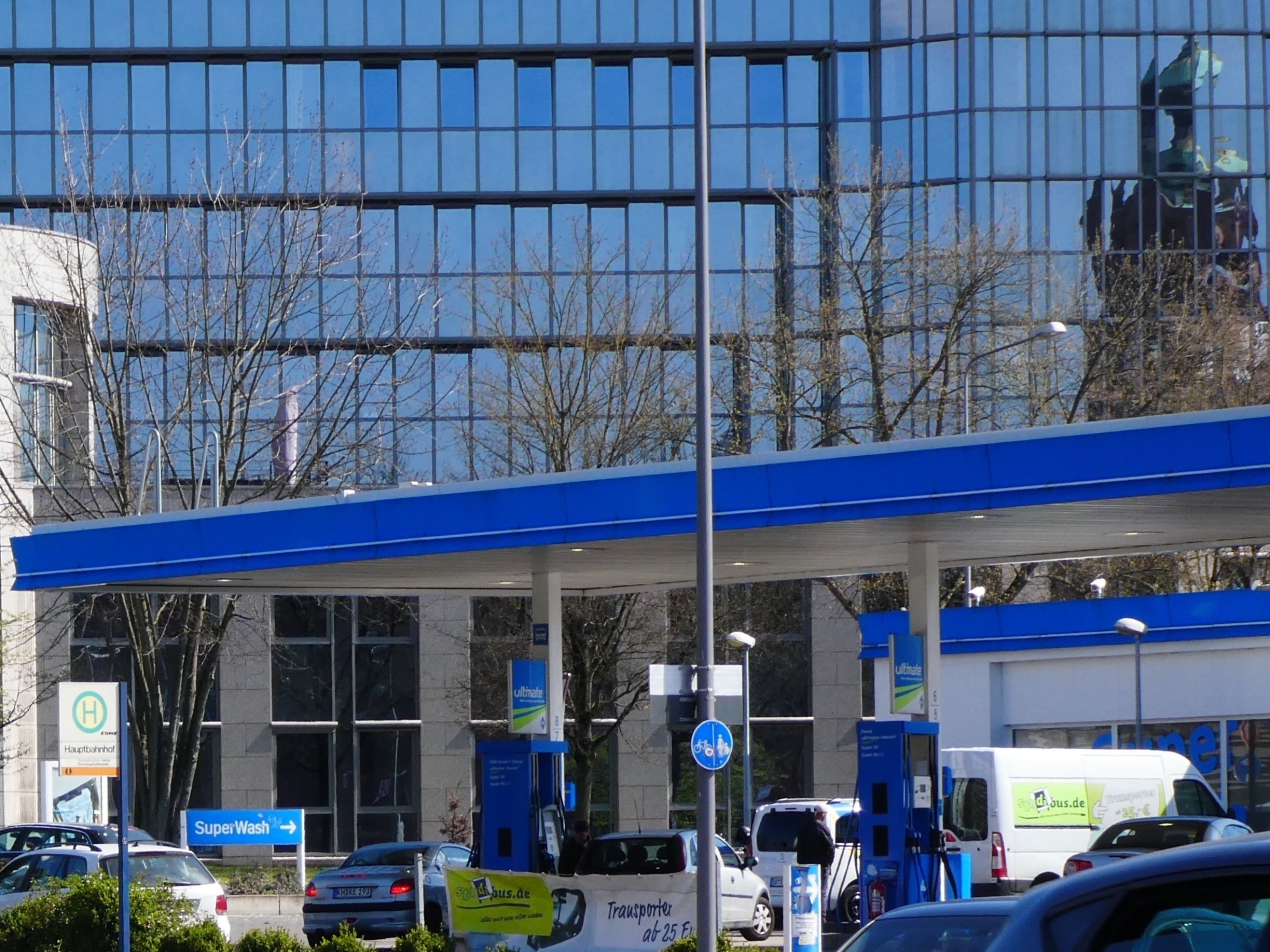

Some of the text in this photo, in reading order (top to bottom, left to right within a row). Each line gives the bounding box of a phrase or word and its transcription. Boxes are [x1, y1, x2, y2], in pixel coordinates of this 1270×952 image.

[895, 662, 922, 676] ultimate
[514, 686, 543, 699] ultimate
[82, 700, 97, 724] H
[64, 745, 115, 754] Hauptbahnhof
[195, 820, 270, 837] SuperWash
[608, 898, 672, 925] Transporter
[642, 920, 661, 942] ab
[662, 923, 678, 942] 25
